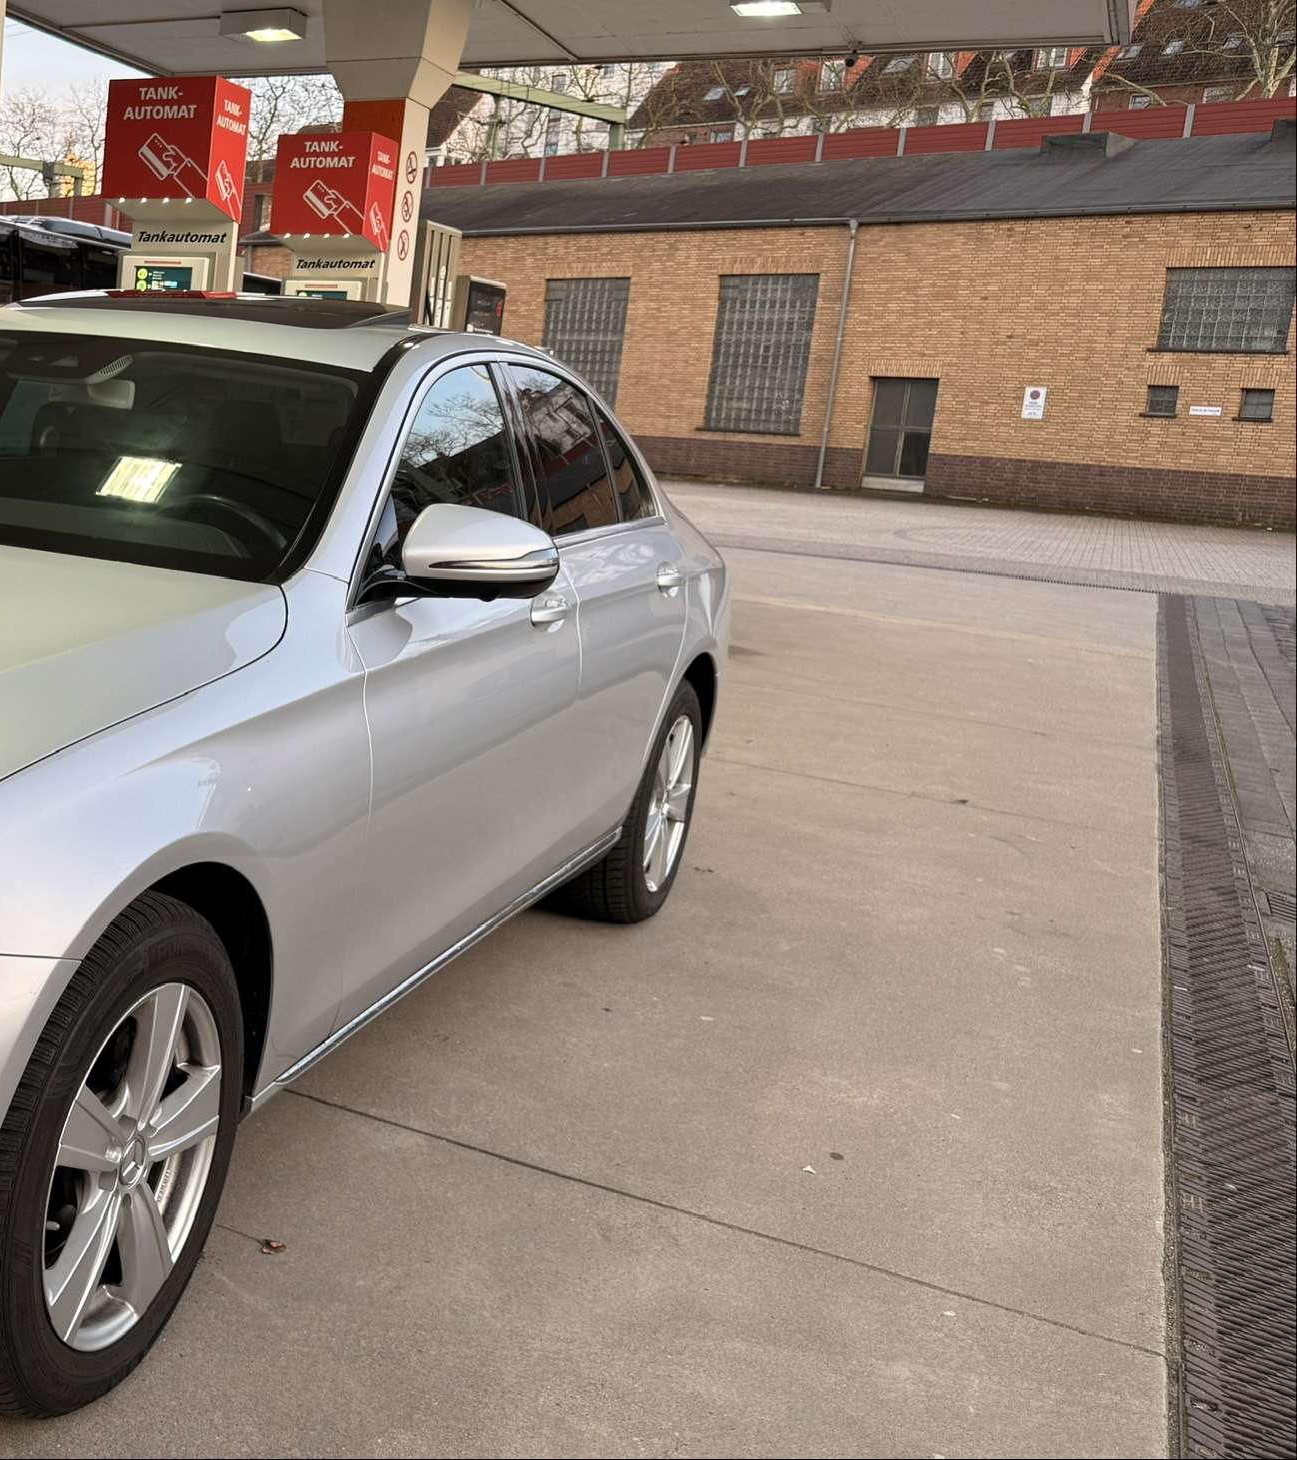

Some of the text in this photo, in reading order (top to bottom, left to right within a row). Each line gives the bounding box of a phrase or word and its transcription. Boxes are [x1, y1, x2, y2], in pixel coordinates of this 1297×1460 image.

[138, 86, 183, 101] TANK-
[123, 105, 197, 120] AUTOMAT
[224, 99, 243, 117] TANK-
[216, 115, 246, 136] AUTOMAT
[304, 141, 343, 153] TANK-
[290, 156, 356, 169] AUTOMAT
[371, 164, 394, 181] AUTOMAT
[138, 231, 227, 244] Tankautomat
[296, 258, 375, 270] Tankautomat
